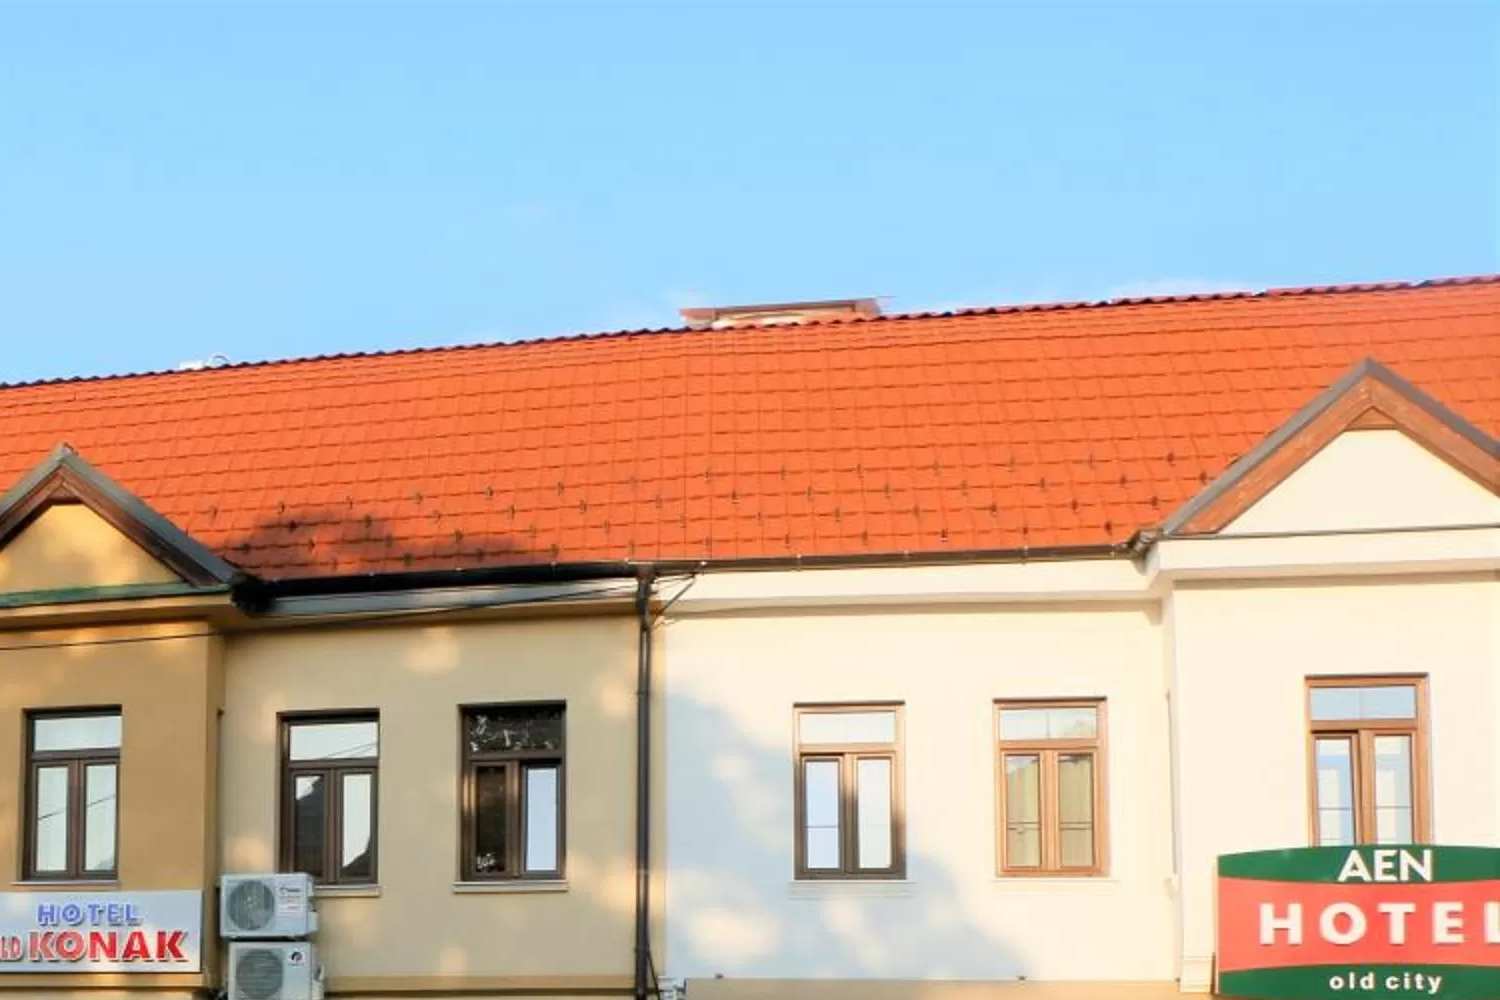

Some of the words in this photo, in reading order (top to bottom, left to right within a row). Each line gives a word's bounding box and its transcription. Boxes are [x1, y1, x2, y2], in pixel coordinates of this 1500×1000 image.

[1337, 849, 1432, 882] AEN
[37, 903, 142, 926] HOTEL
[1259, 902, 1500, 945] HOTEL
[28, 930, 187, 961] KONAK
[1329, 972, 1375, 991] old
[1385, 972, 1442, 994] city
